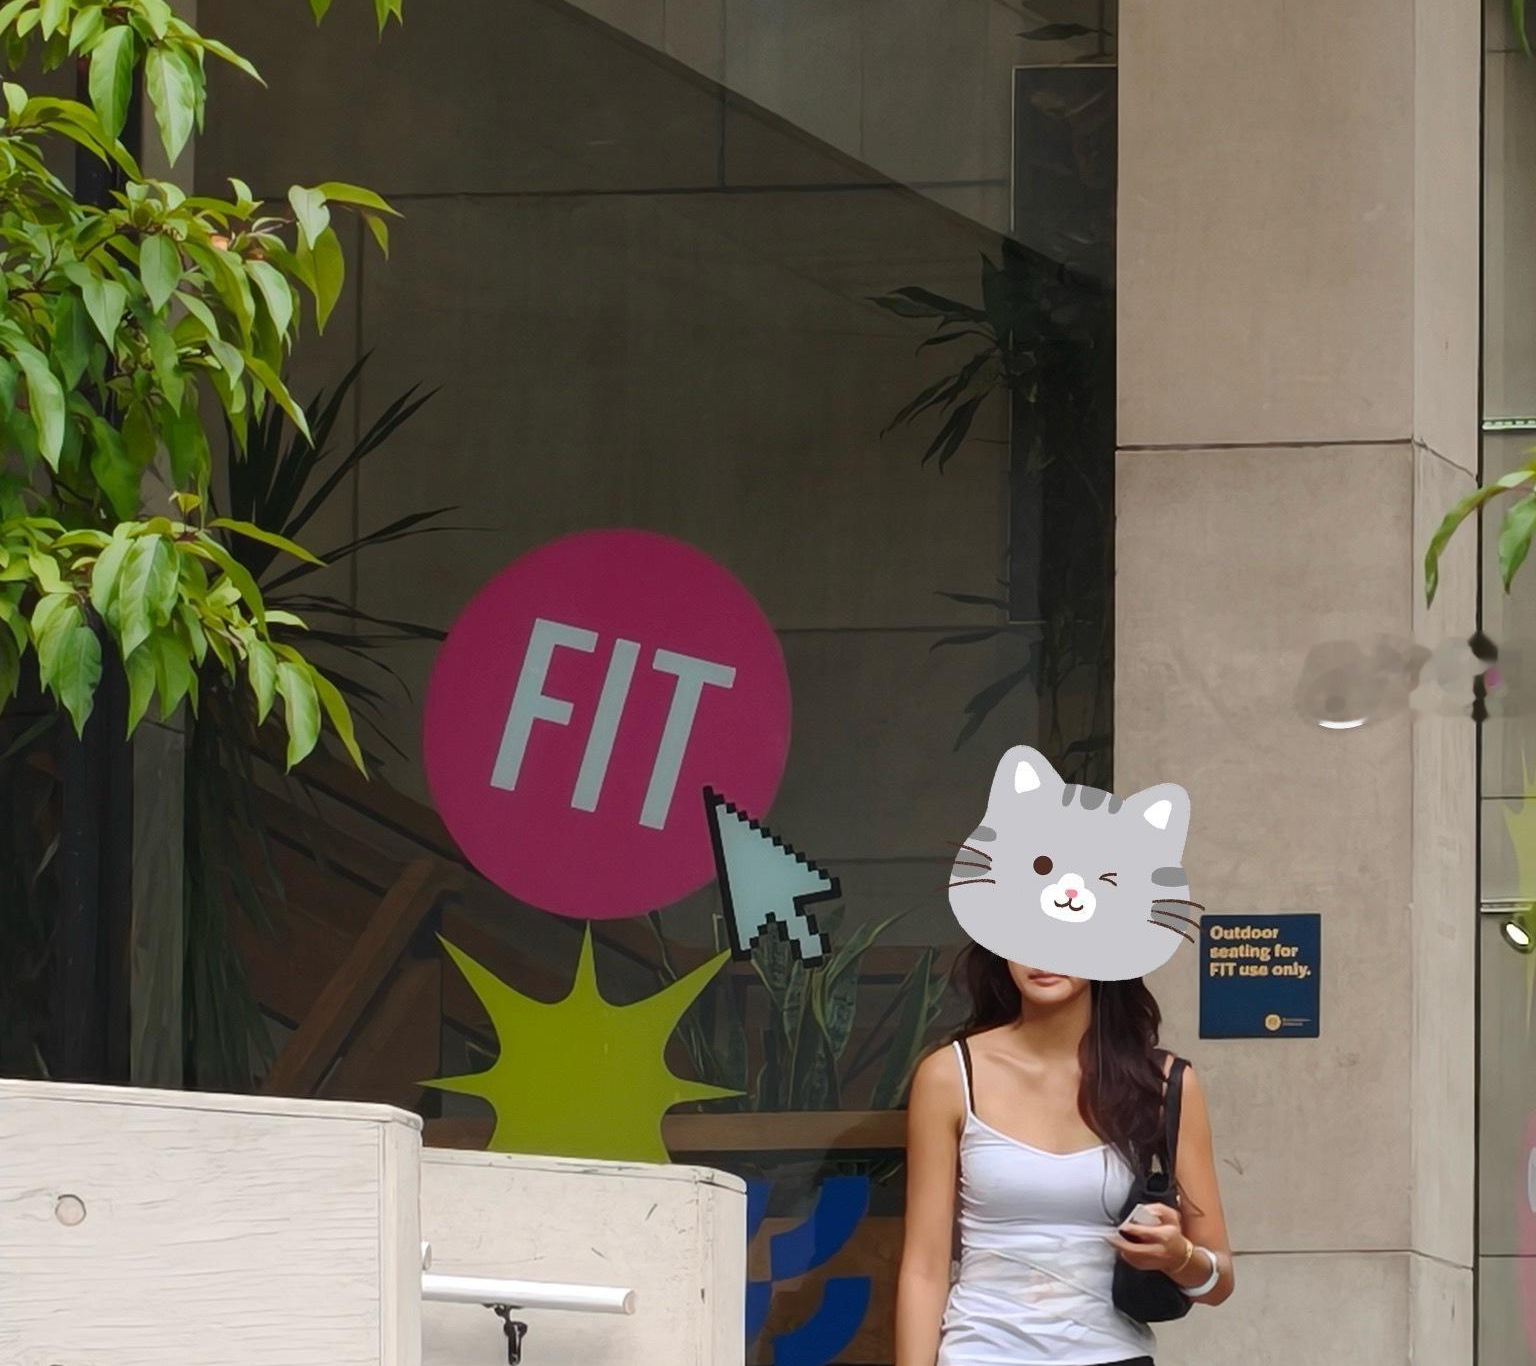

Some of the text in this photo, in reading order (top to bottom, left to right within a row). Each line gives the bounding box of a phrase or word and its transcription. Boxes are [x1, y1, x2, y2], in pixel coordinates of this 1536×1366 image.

[489, 617, 738, 831] FIT
[1209, 924, 1279, 941] Outdoor
[1209, 943, 1299, 962] seating for
[1209, 961, 1312, 979] FIT use only.
